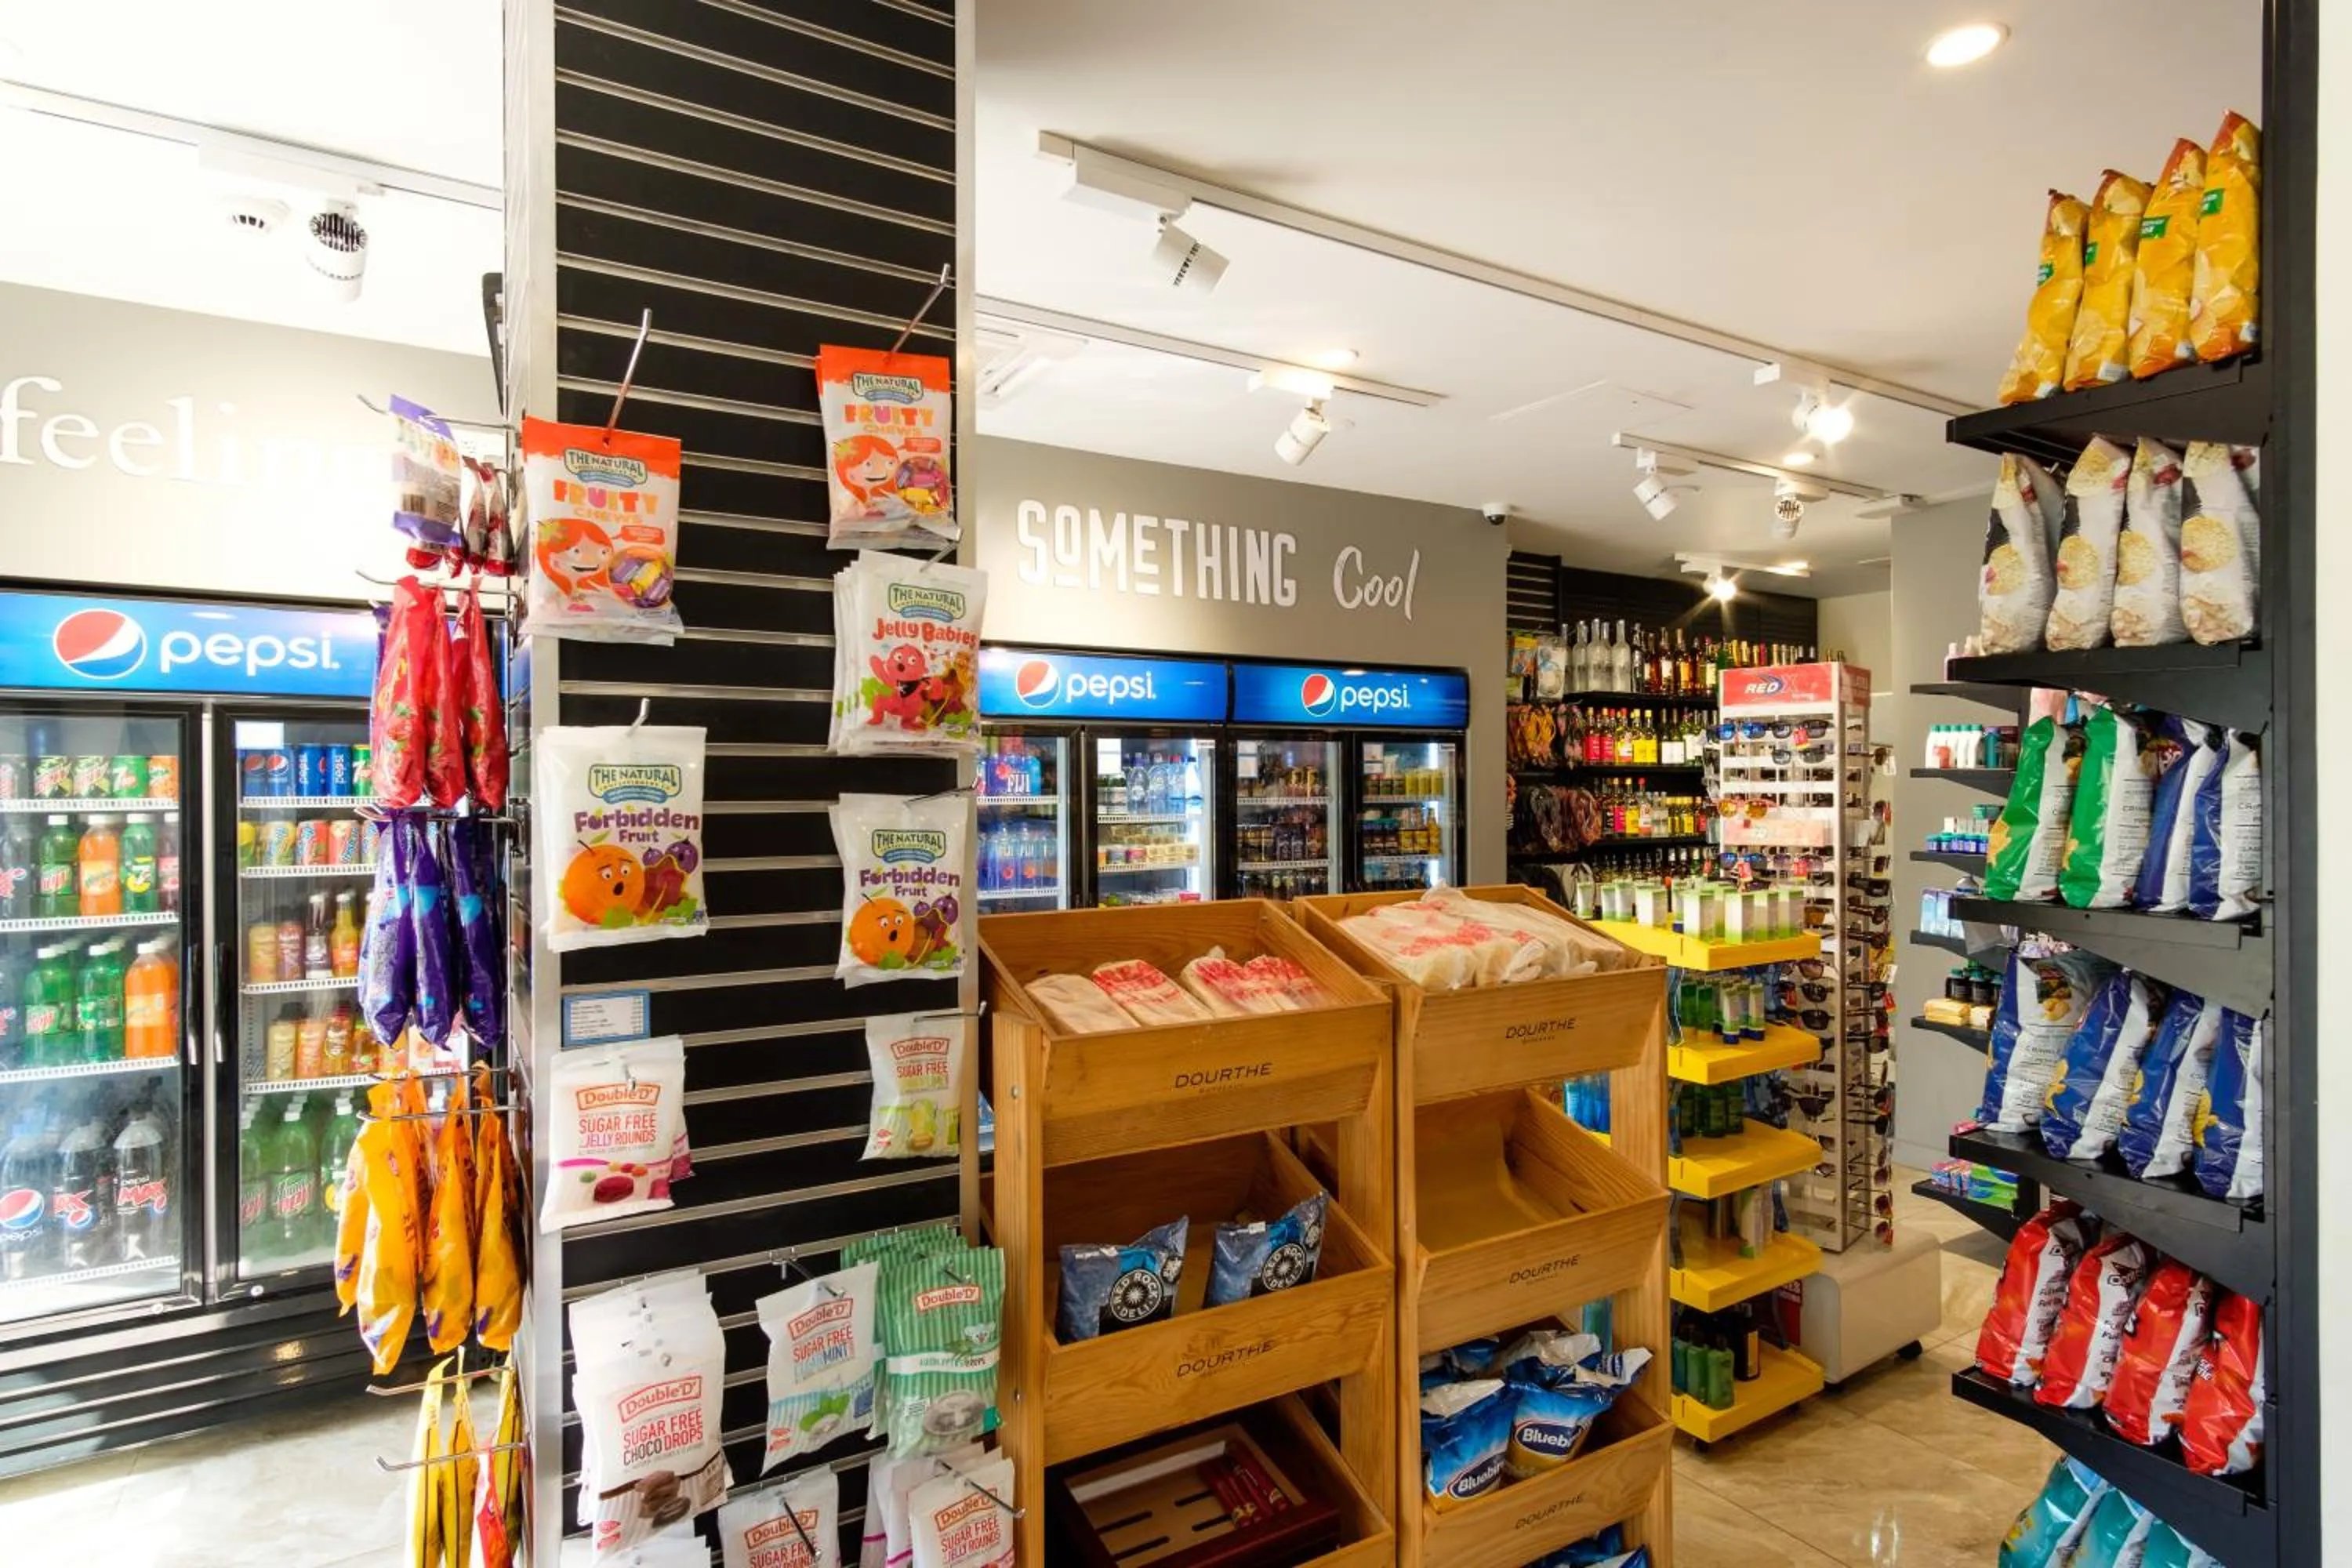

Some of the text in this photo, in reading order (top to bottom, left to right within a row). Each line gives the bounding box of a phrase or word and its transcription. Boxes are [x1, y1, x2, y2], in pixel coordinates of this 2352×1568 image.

[855, 375, 920, 394] THE NATURAL
[844, 404, 935, 426] FRUITY
[0, 376, 392, 495] feelin
[568, 451, 589, 464] THE
[592, 456, 644, 477] NATURAL
[554, 479, 659, 515] FRUITY
[1017, 499, 1421, 622] SOMETHING Cool
[893, 587, 913, 602] THE
[915, 590, 962, 612] NATURAL
[871, 618, 978, 649] Jelly Babies
[1744, 682, 1780, 695] RED
[593, 768, 617, 787] THE
[619, 768, 677, 787] NATURAL
[574, 807, 700, 833] Forbidden
[619, 829, 659, 843] Fruit
[876, 833, 894, 849] THE
[896, 833, 942, 849] NATURAL
[859, 866, 960, 887] Forbidden
[894, 885, 927, 897] Fruit
[1505, 1018, 1576, 1039] DOURTHE
[1175, 1062, 1273, 1088] DOURTHE
[579, 1112, 656, 1134] SUGAR FREE
[586, 1129, 656, 1148] JELLY ROUNDS
[1509, 1254, 1581, 1283] DOURTHE
[793, 1324, 854, 1363] SUGAR FREE
[1178, 1339, 1275, 1377] DOURTHE
[623, 1407, 702, 1450] SUGAR FREE
[623, 1438, 662, 1466] CHOCO
[664, 1426, 703, 1450] DROPS
[1515, 1490, 1585, 1530] DOURTHE
[941, 1515, 1000, 1552] SUGAR FREE
